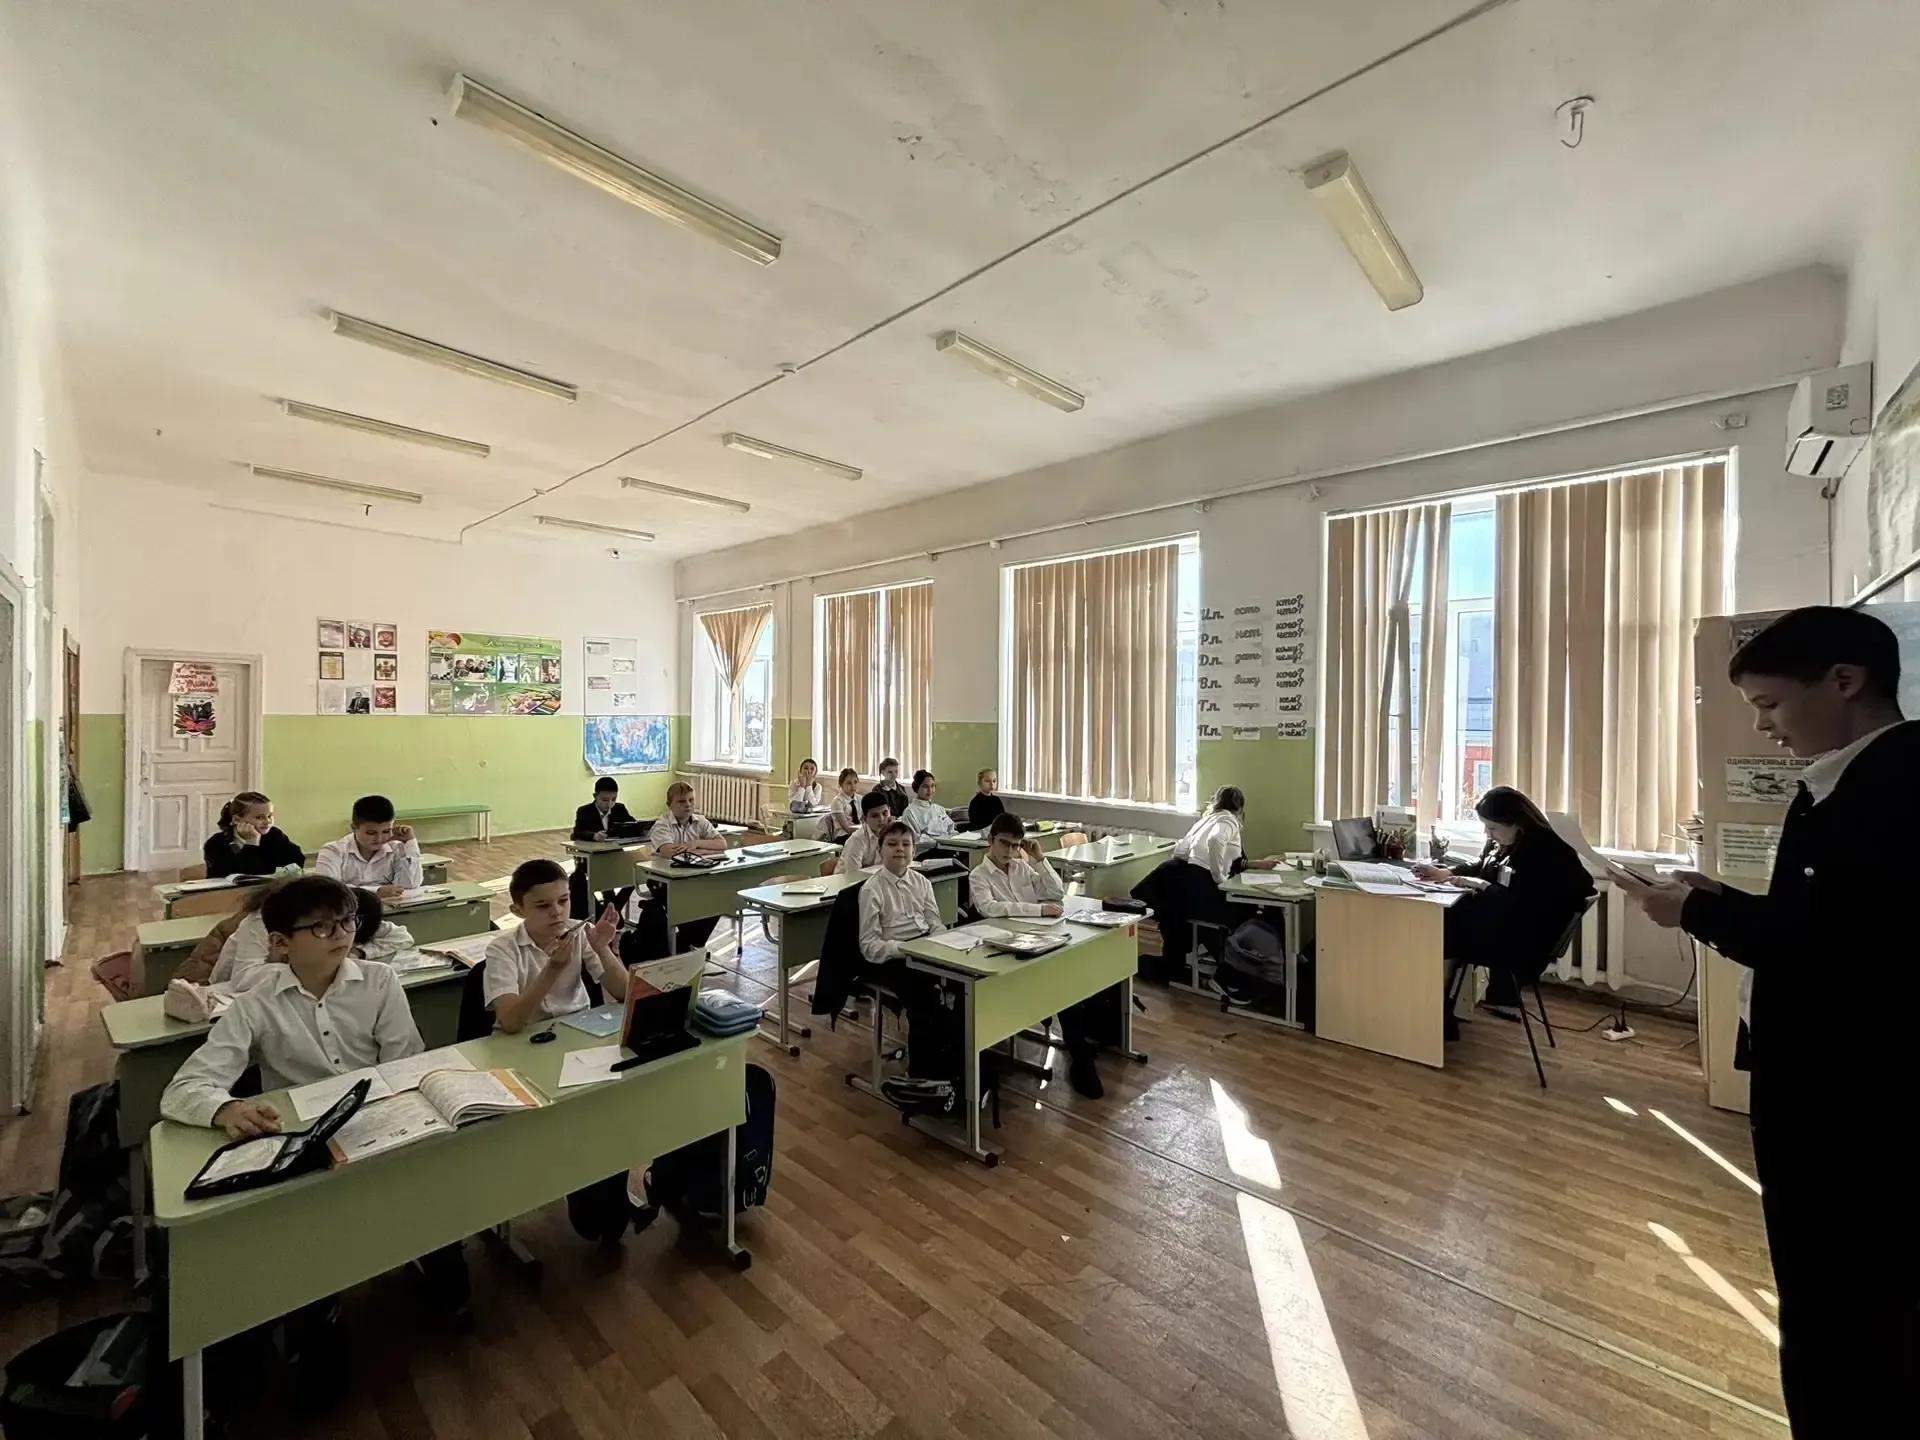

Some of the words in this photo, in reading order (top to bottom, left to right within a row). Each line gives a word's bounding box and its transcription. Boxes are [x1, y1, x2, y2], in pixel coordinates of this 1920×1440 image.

[1276, 594, 1303, 607] кто?
[1277, 604, 1304, 615] что?
[1276, 618, 1304, 630] кого?
[1277, 628, 1304, 638] чего?
[1200, 633, 1222, 645] Р.п.
[1275, 643, 1304, 655] кому?
[1199, 654, 1223, 666] Д.п.
[1276, 668, 1304, 678] кого?
[1198, 677, 1222, 689] В.п.
[1276, 678, 1304, 688] что?
[1279, 694, 1301, 703] кем?
[1198, 699, 1220, 711] Т.п.
[1279, 703, 1302, 711] чем?
[1198, 725, 1222, 736] П.п.
[1727, 758, 1787, 766] ОДНОКОРЕННЫЕ
